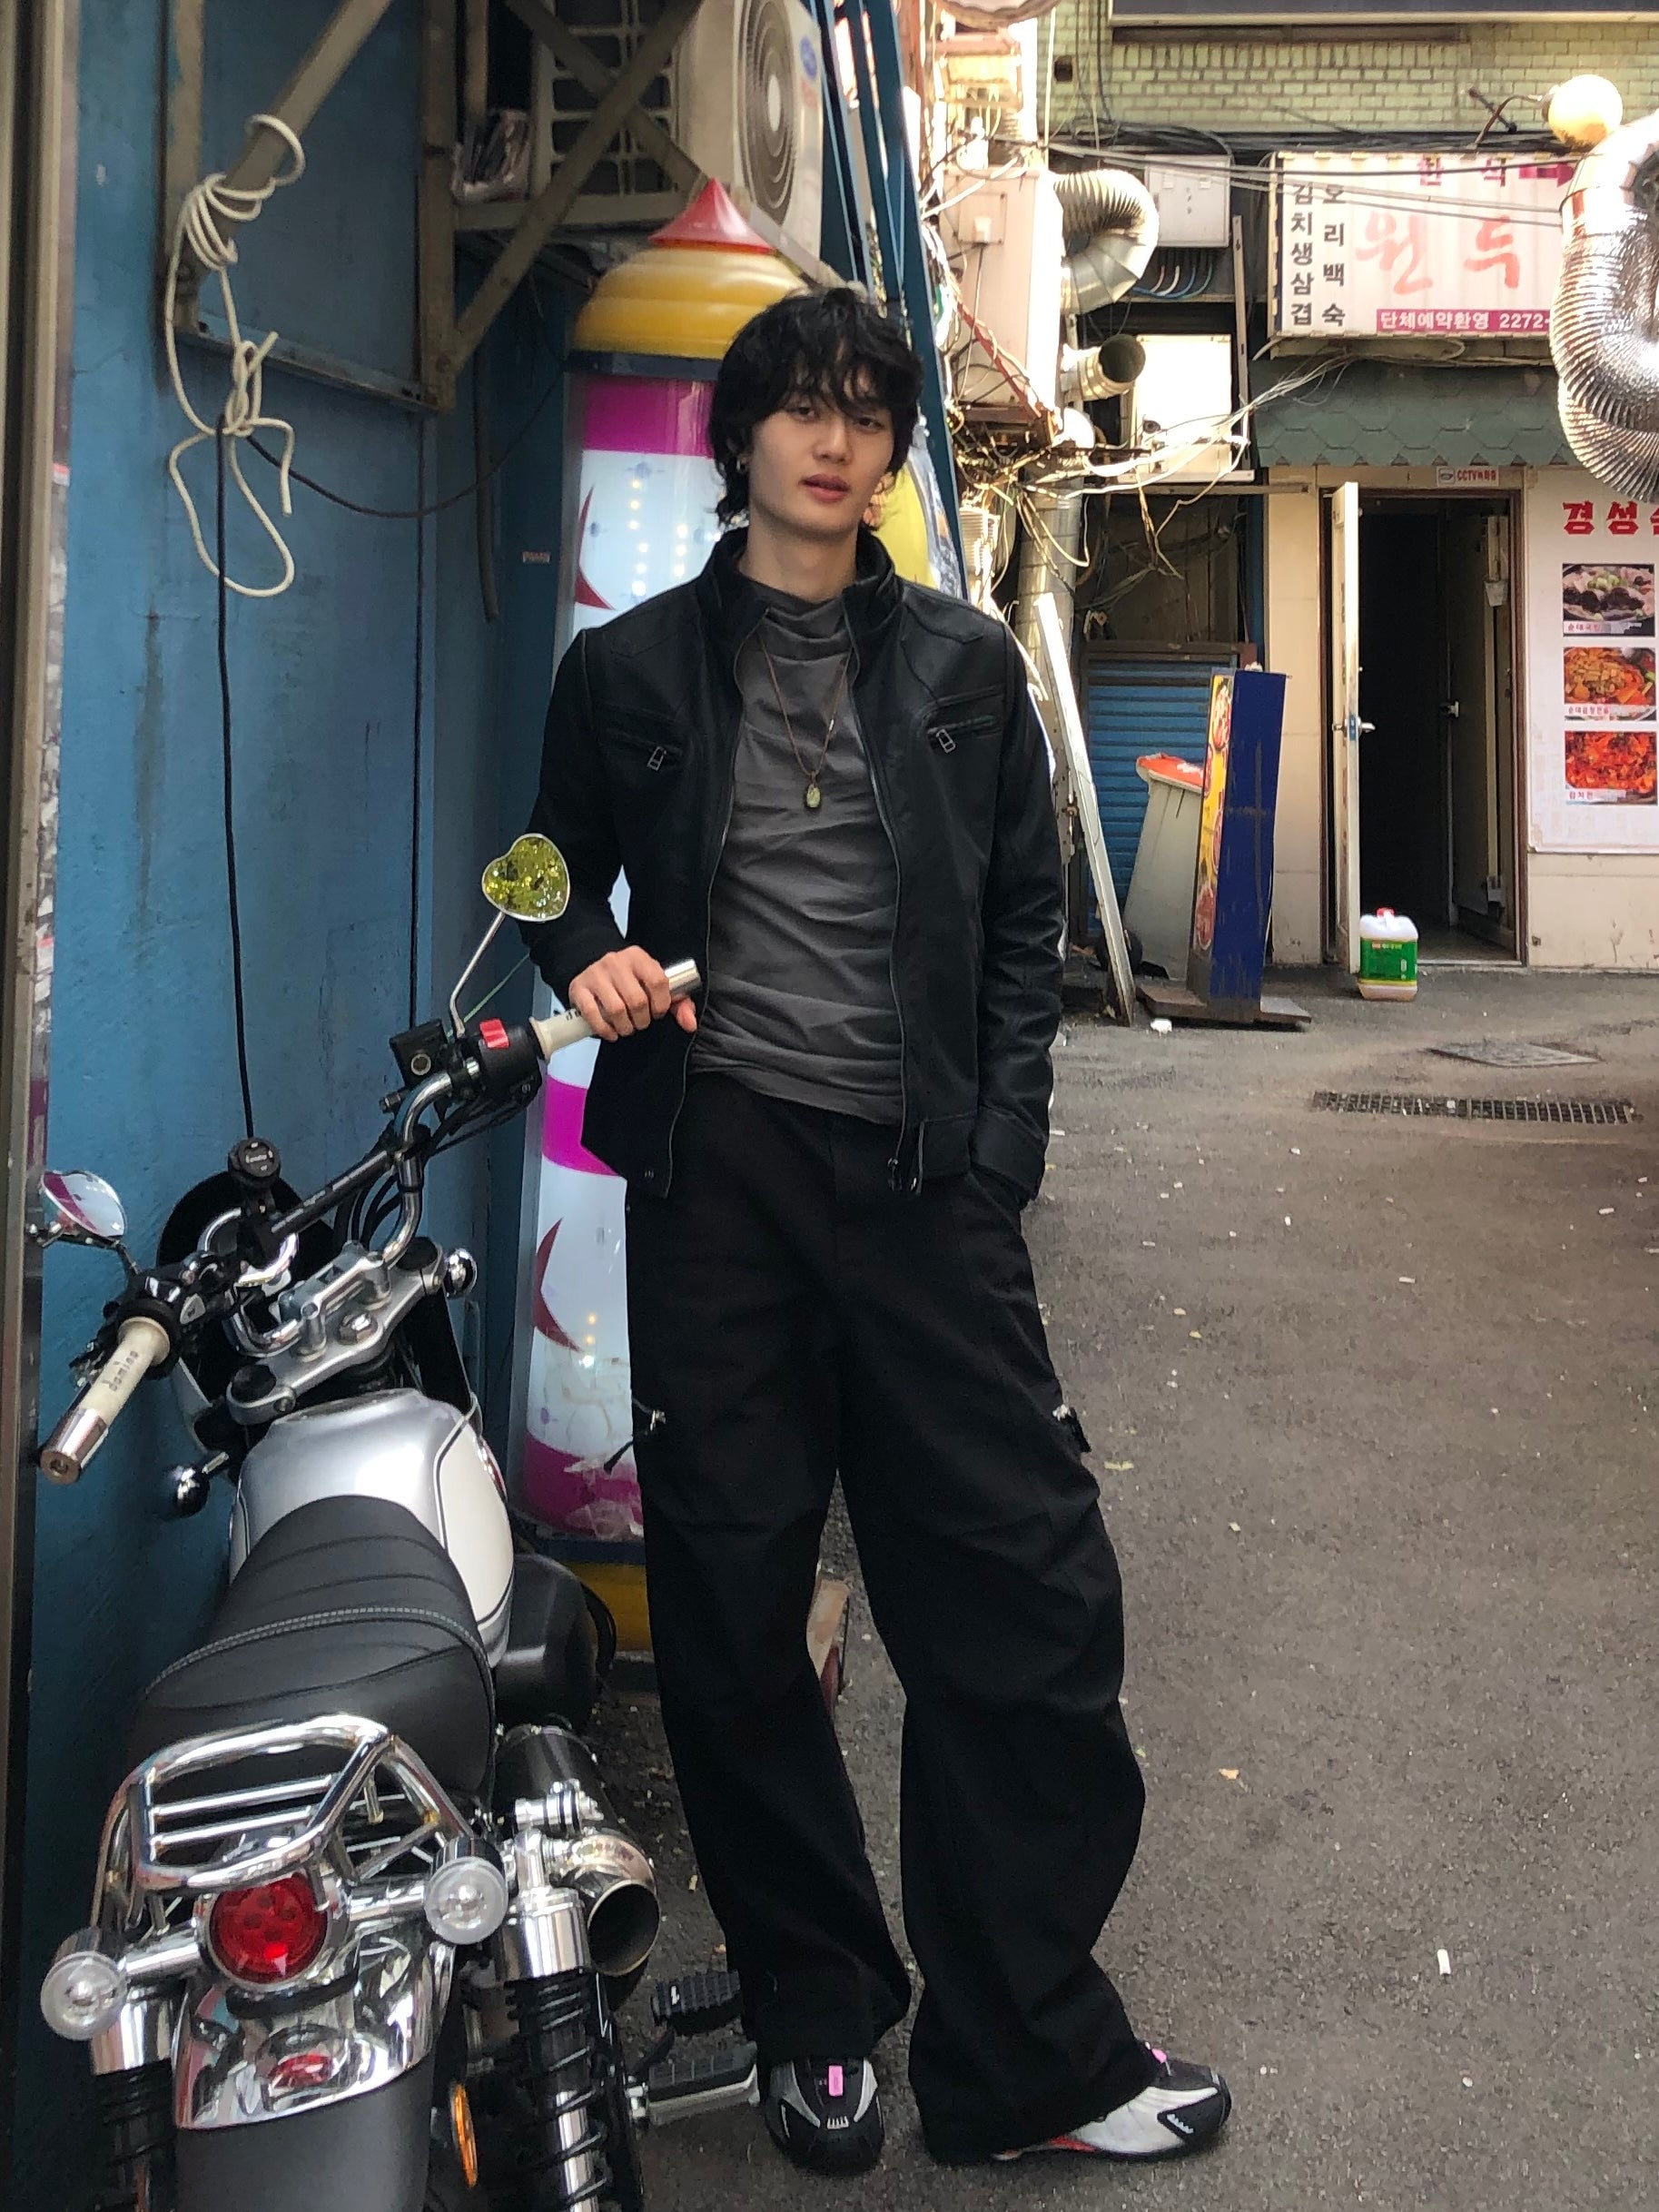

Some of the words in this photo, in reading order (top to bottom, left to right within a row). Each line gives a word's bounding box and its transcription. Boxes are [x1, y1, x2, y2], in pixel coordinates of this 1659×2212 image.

[1290, 181, 1314, 326] 김치생삼겹
[1321, 183, 1346, 327] 오리백숙
[1380, 311, 1489, 330] 단체예약환영
